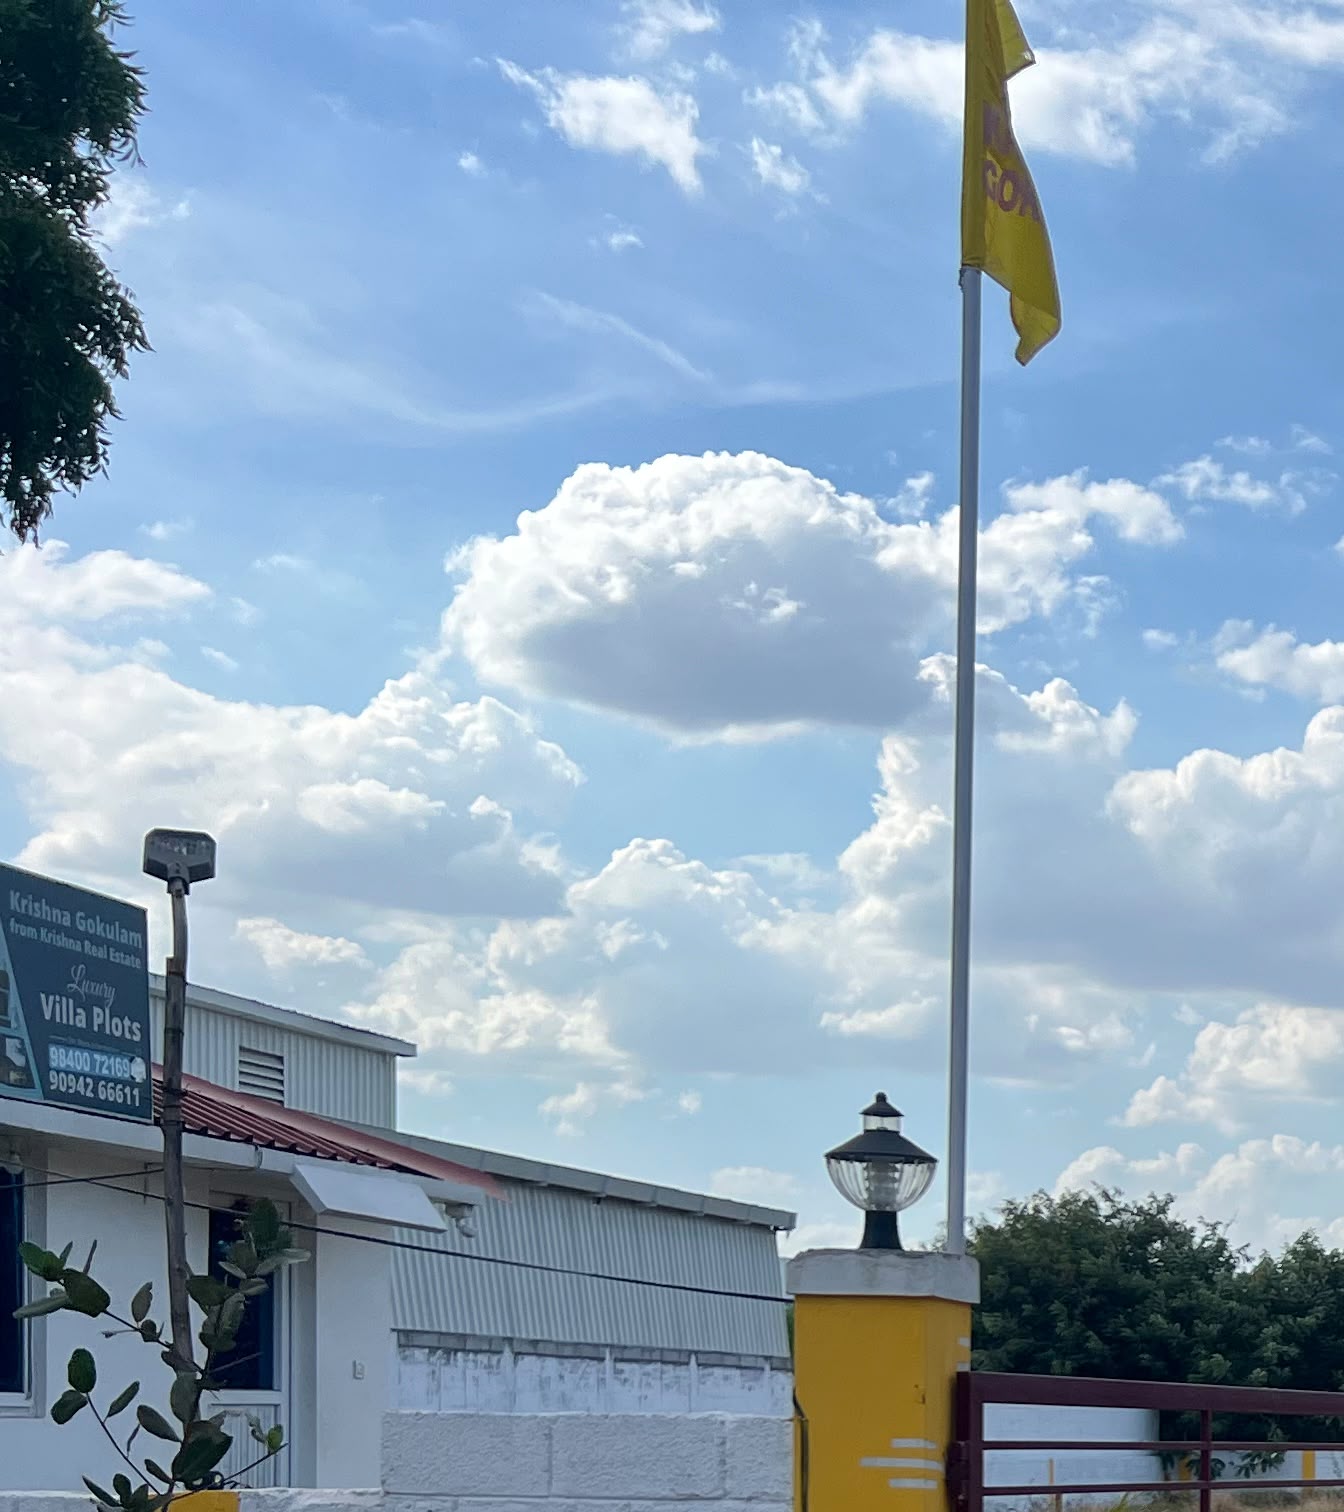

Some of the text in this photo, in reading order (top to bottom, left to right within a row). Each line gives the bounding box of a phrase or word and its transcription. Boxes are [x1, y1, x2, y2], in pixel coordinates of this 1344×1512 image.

[9, 889, 143, 949] Krishna Gokulam
[9, 917, 142, 970] from Krishna Real Estate
[66, 963, 116, 1009] Luxury
[40, 991, 142, 1042] Villa Plots
[49, 1046, 131, 1079] 98400 72169
[49, 1069, 140, 1107] 90942 66611
